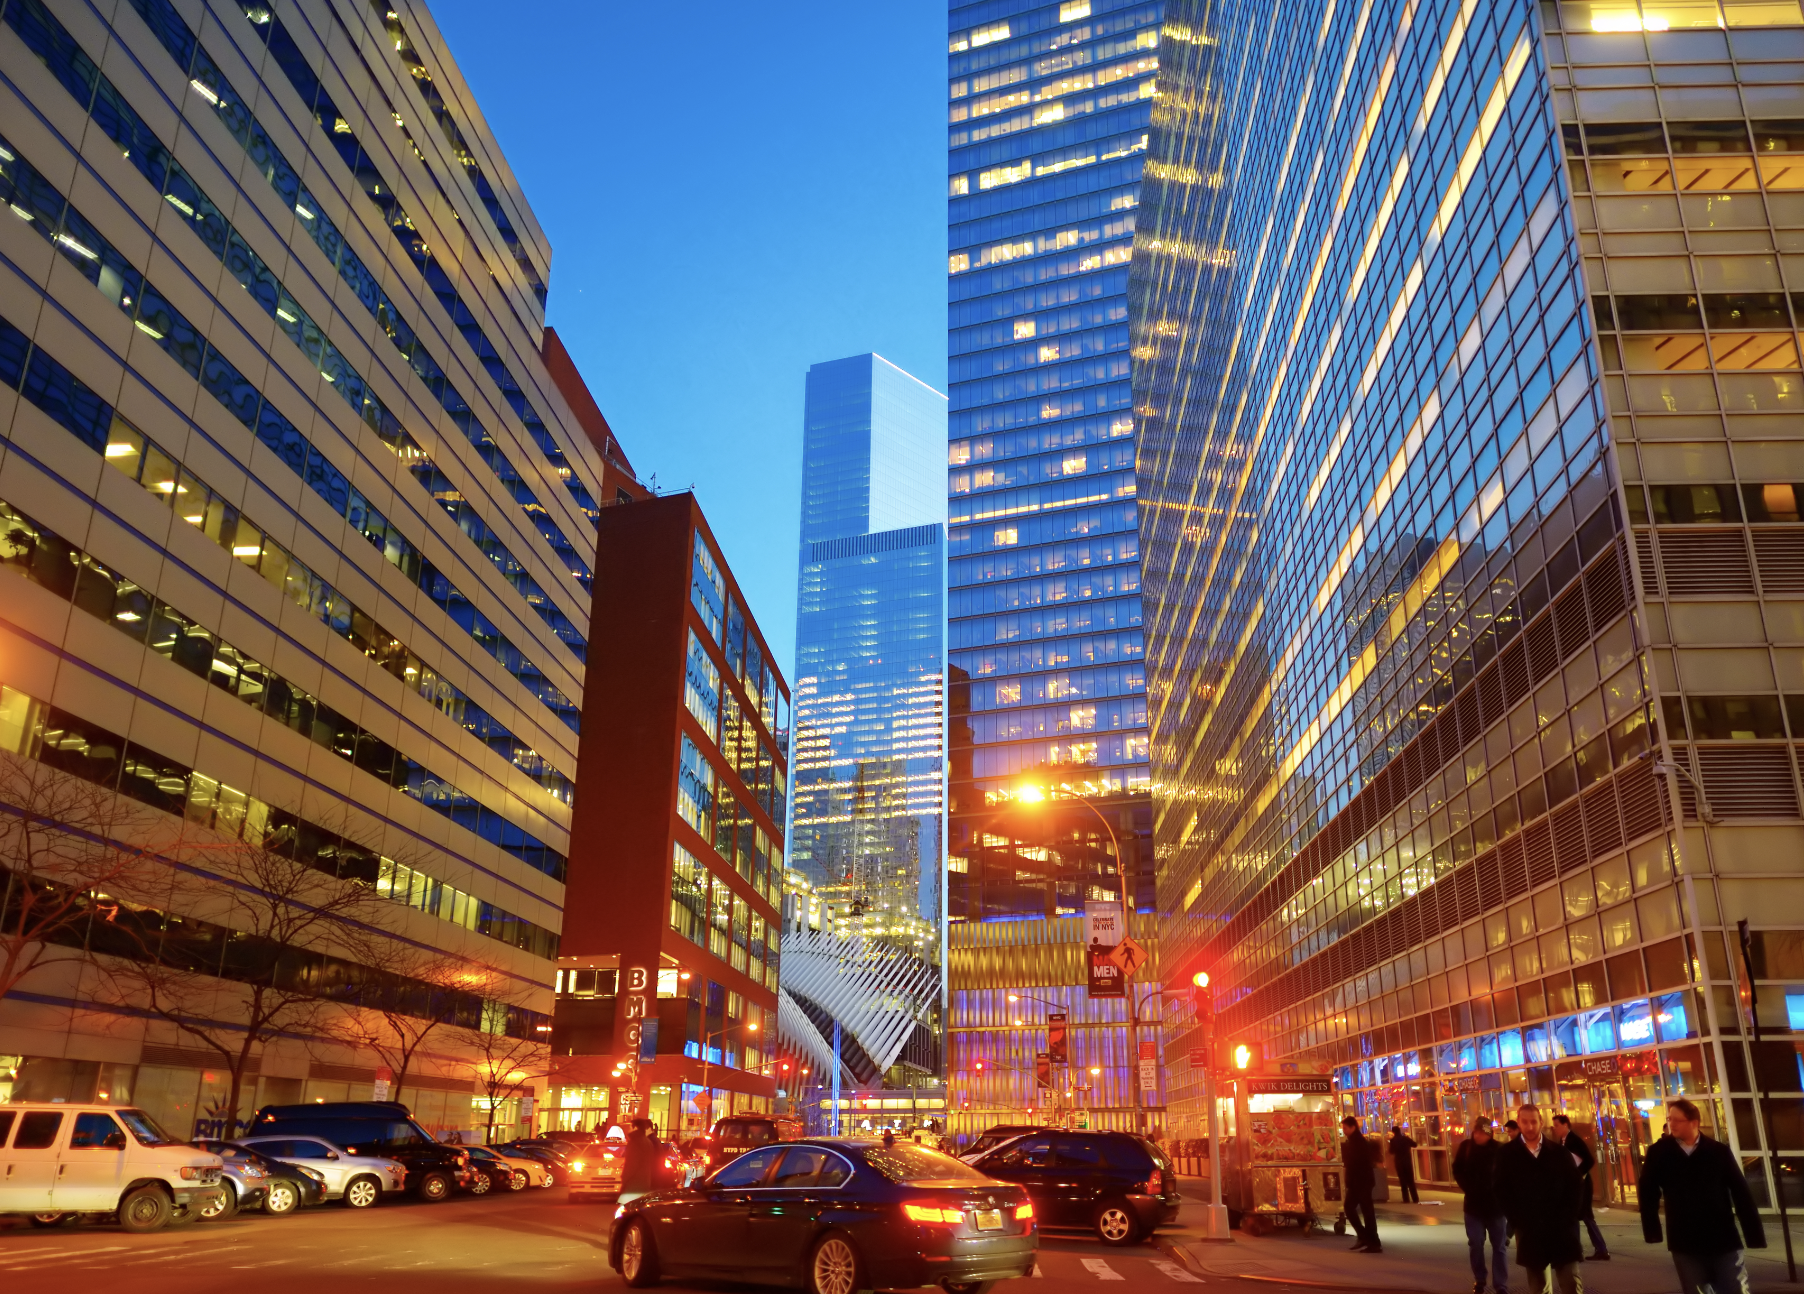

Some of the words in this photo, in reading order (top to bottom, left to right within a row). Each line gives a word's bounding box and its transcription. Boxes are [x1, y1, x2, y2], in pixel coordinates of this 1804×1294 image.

[1093, 955, 1117, 967] MA
[1094, 966, 1118, 978] MEN
[1586, 1060, 1612, 1075] CHASE
[1252, 1082, 1278, 1091] KWIK
[1280, 1082, 1328, 1091] DELIGHTS
